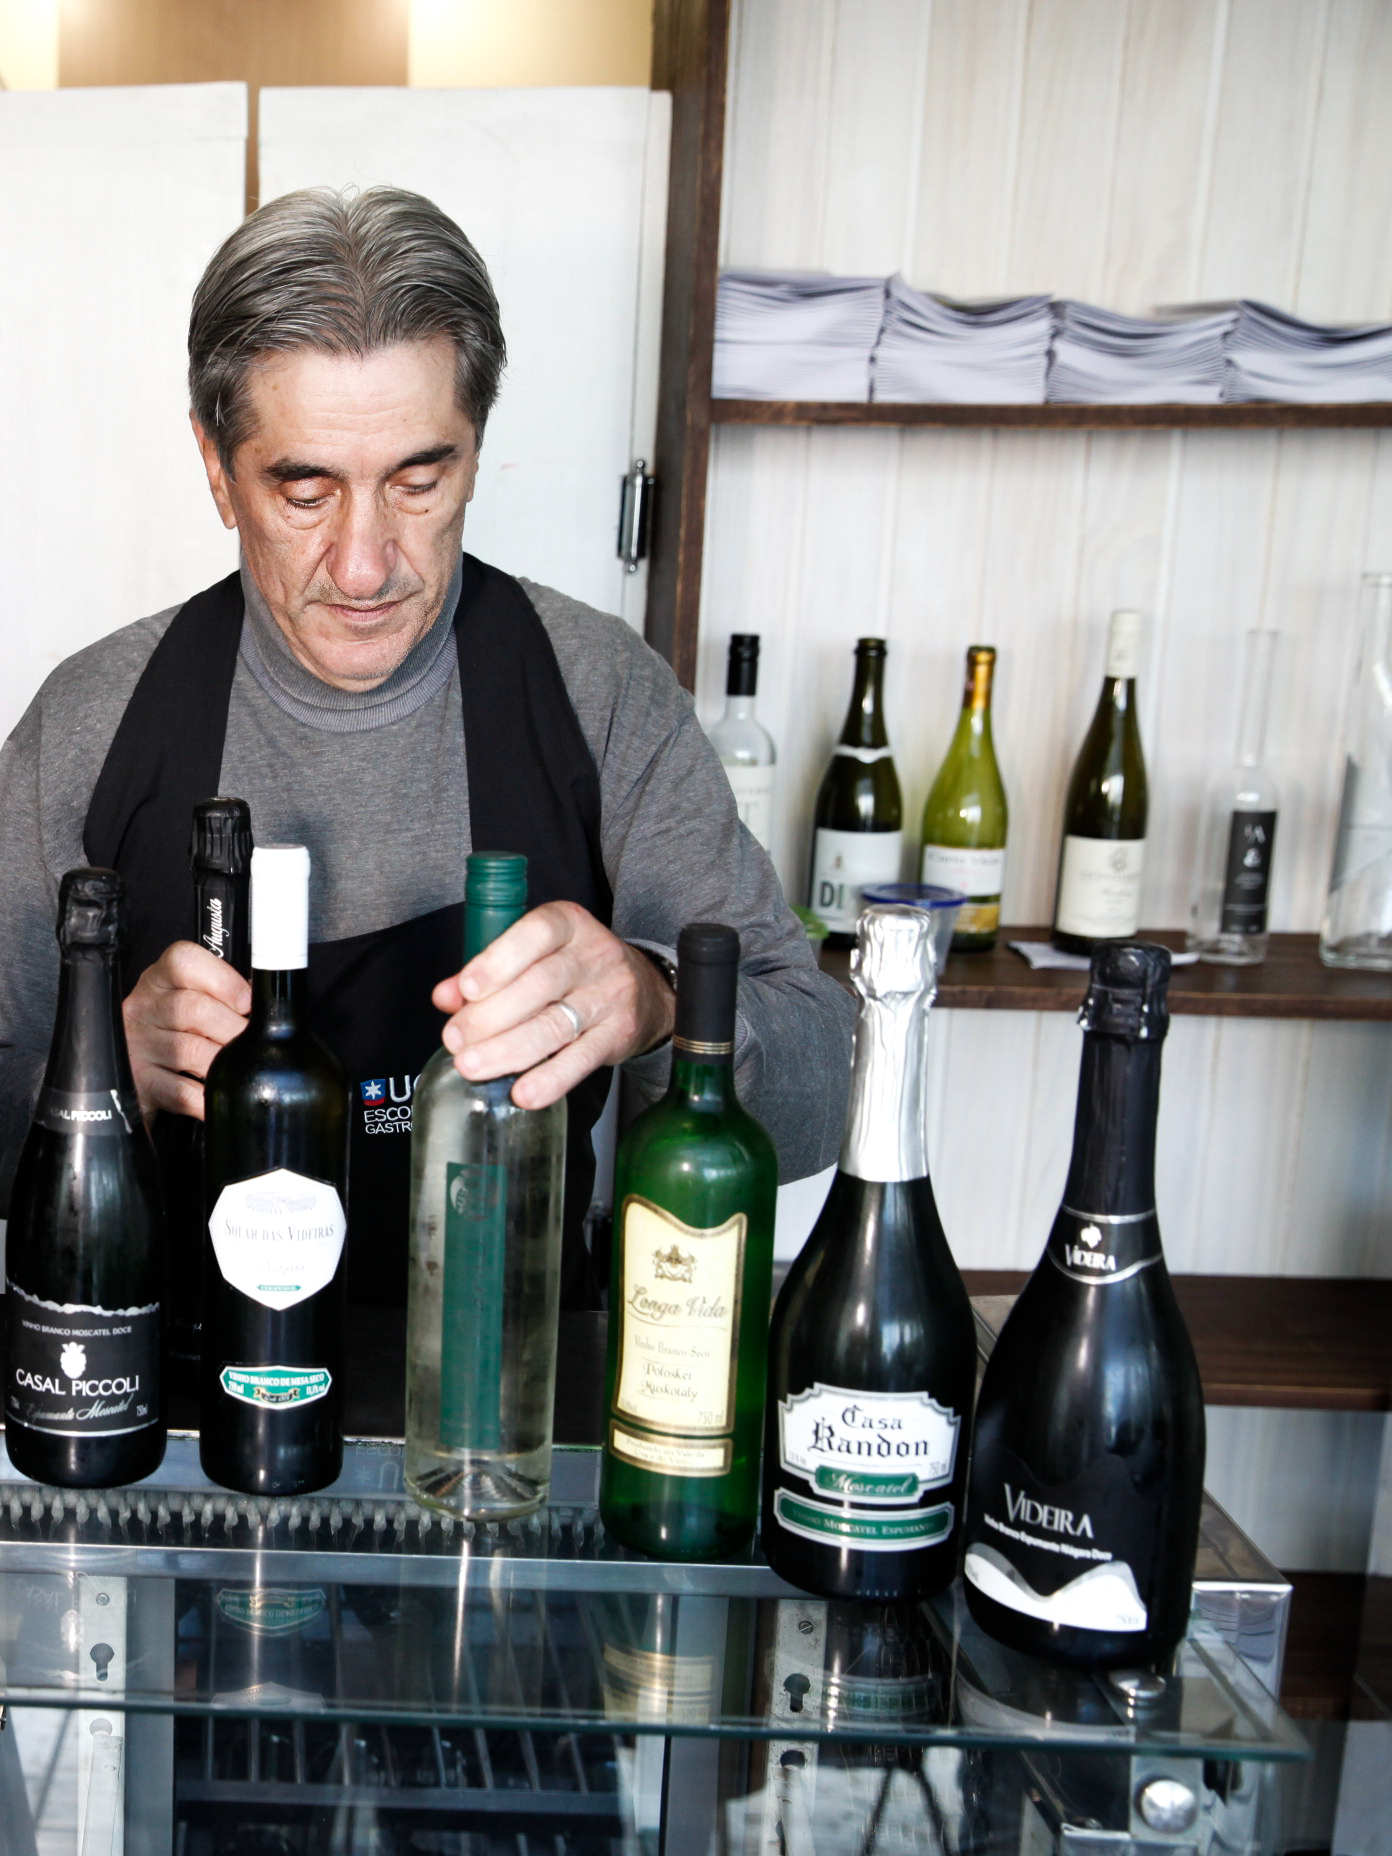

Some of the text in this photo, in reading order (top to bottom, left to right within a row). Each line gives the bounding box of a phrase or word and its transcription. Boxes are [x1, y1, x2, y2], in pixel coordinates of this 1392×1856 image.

[202, 897, 230, 959] Augusta
[70, 1109, 113, 1122] PICCOLI
[365, 1120, 413, 1135] GASTR
[1064, 1243, 1117, 1272] VIDEIRA
[626, 1283, 728, 1321] Longa Vida
[41, 1324, 70, 1336] BRANCO
[71, 1327, 111, 1337] MOSCATEL
[112, 1325, 133, 1335] DOCE
[633, 1333, 655, 1351] Vinho
[657, 1340, 687, 1357] Branco
[15, 1367, 140, 1398] CASAL PICCOLI
[228, 1370, 325, 1387] VINHO BRANCO DE MESA SECO
[696, 1410, 713, 1425] 750
[840, 1403, 905, 1431] Casa
[806, 1415, 930, 1459] Randon
[824, 1472, 914, 1495] Moscatel
[1003, 1482, 1094, 1540] VIDEIRA
[823, 1517, 878, 1536] MOSCATEL
